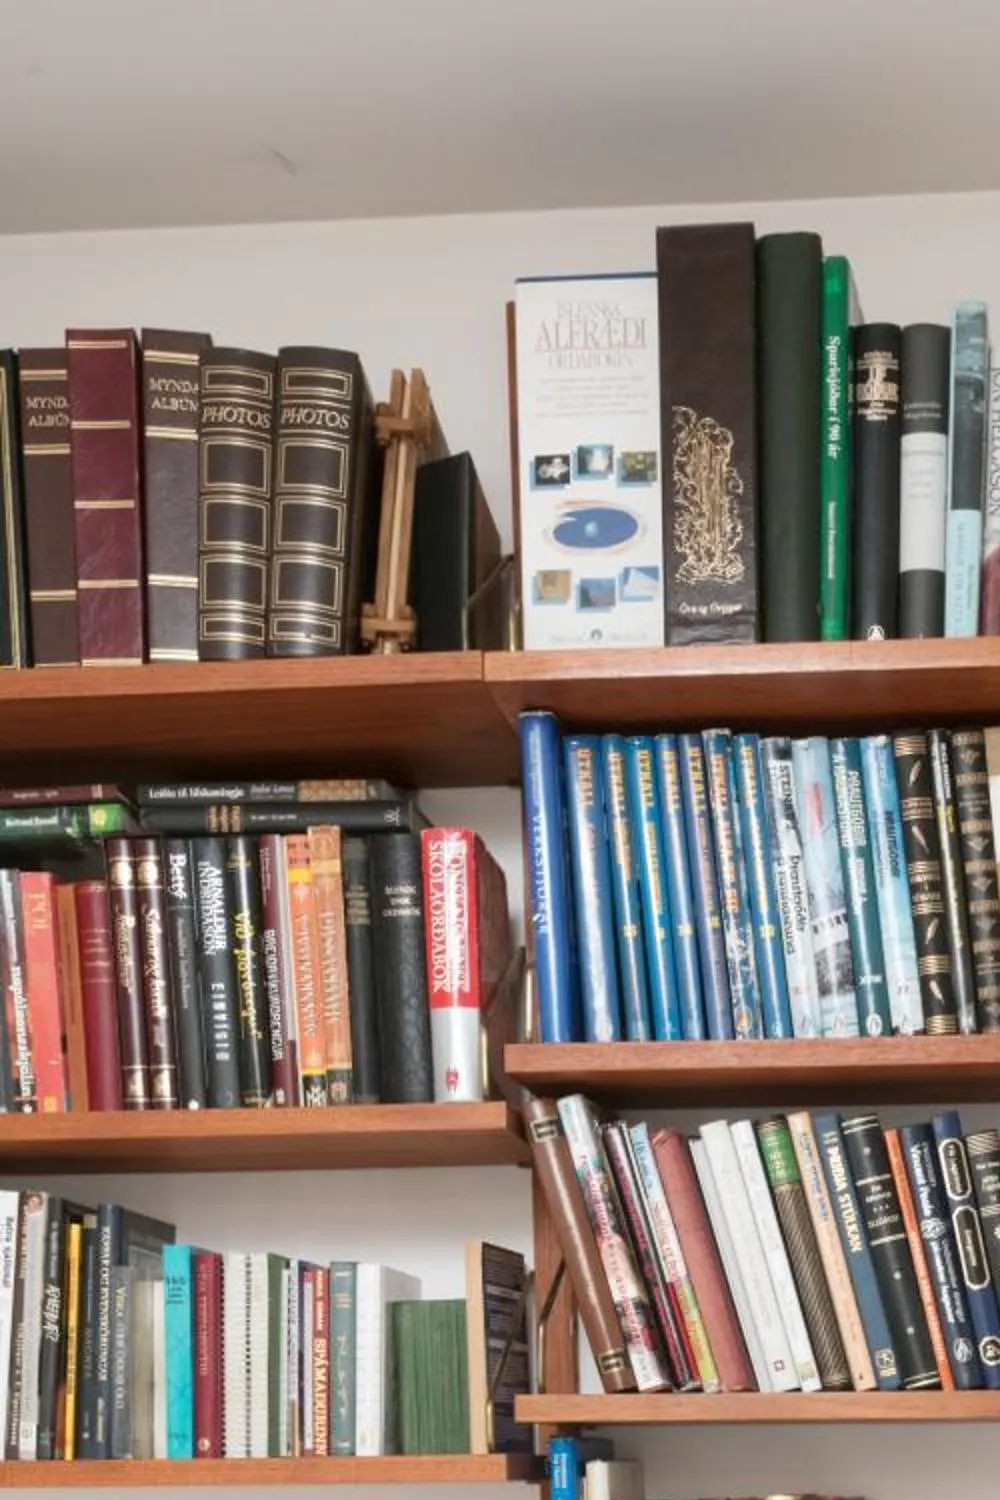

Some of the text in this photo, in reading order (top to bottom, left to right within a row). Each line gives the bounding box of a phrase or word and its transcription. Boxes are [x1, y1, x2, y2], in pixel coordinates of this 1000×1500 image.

[201, 405, 271, 429] PHOTOS
[281, 405, 352, 430] PHOTOS
[168, 853, 189, 901] Betty
